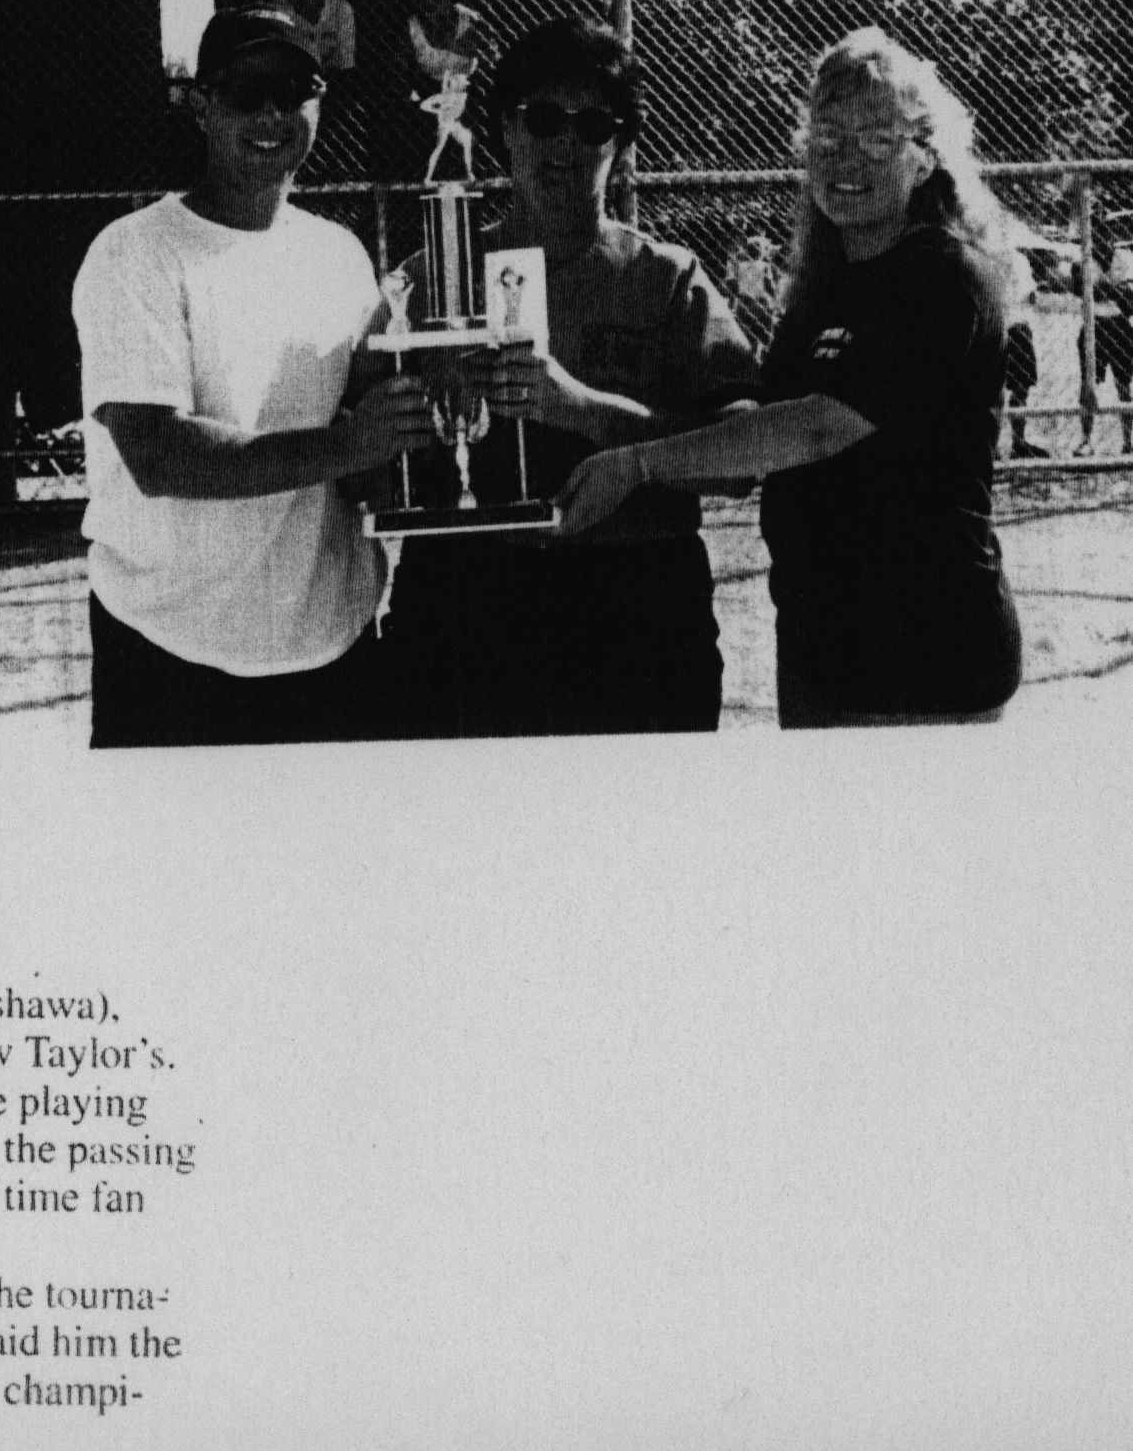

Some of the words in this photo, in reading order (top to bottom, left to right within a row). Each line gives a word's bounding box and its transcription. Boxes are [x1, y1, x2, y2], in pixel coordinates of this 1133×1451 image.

[24, 1035, 175, 1078] Taylor's.
[19, 1084, 148, 1128] playing
[4, 1178, 80, 1213] time
[92, 1180, 145, 1214] fan
[52, 1324, 118, 1358] him
[129, 1325, 182, 1359] the
[3, 1372, 143, 1417] champi-
